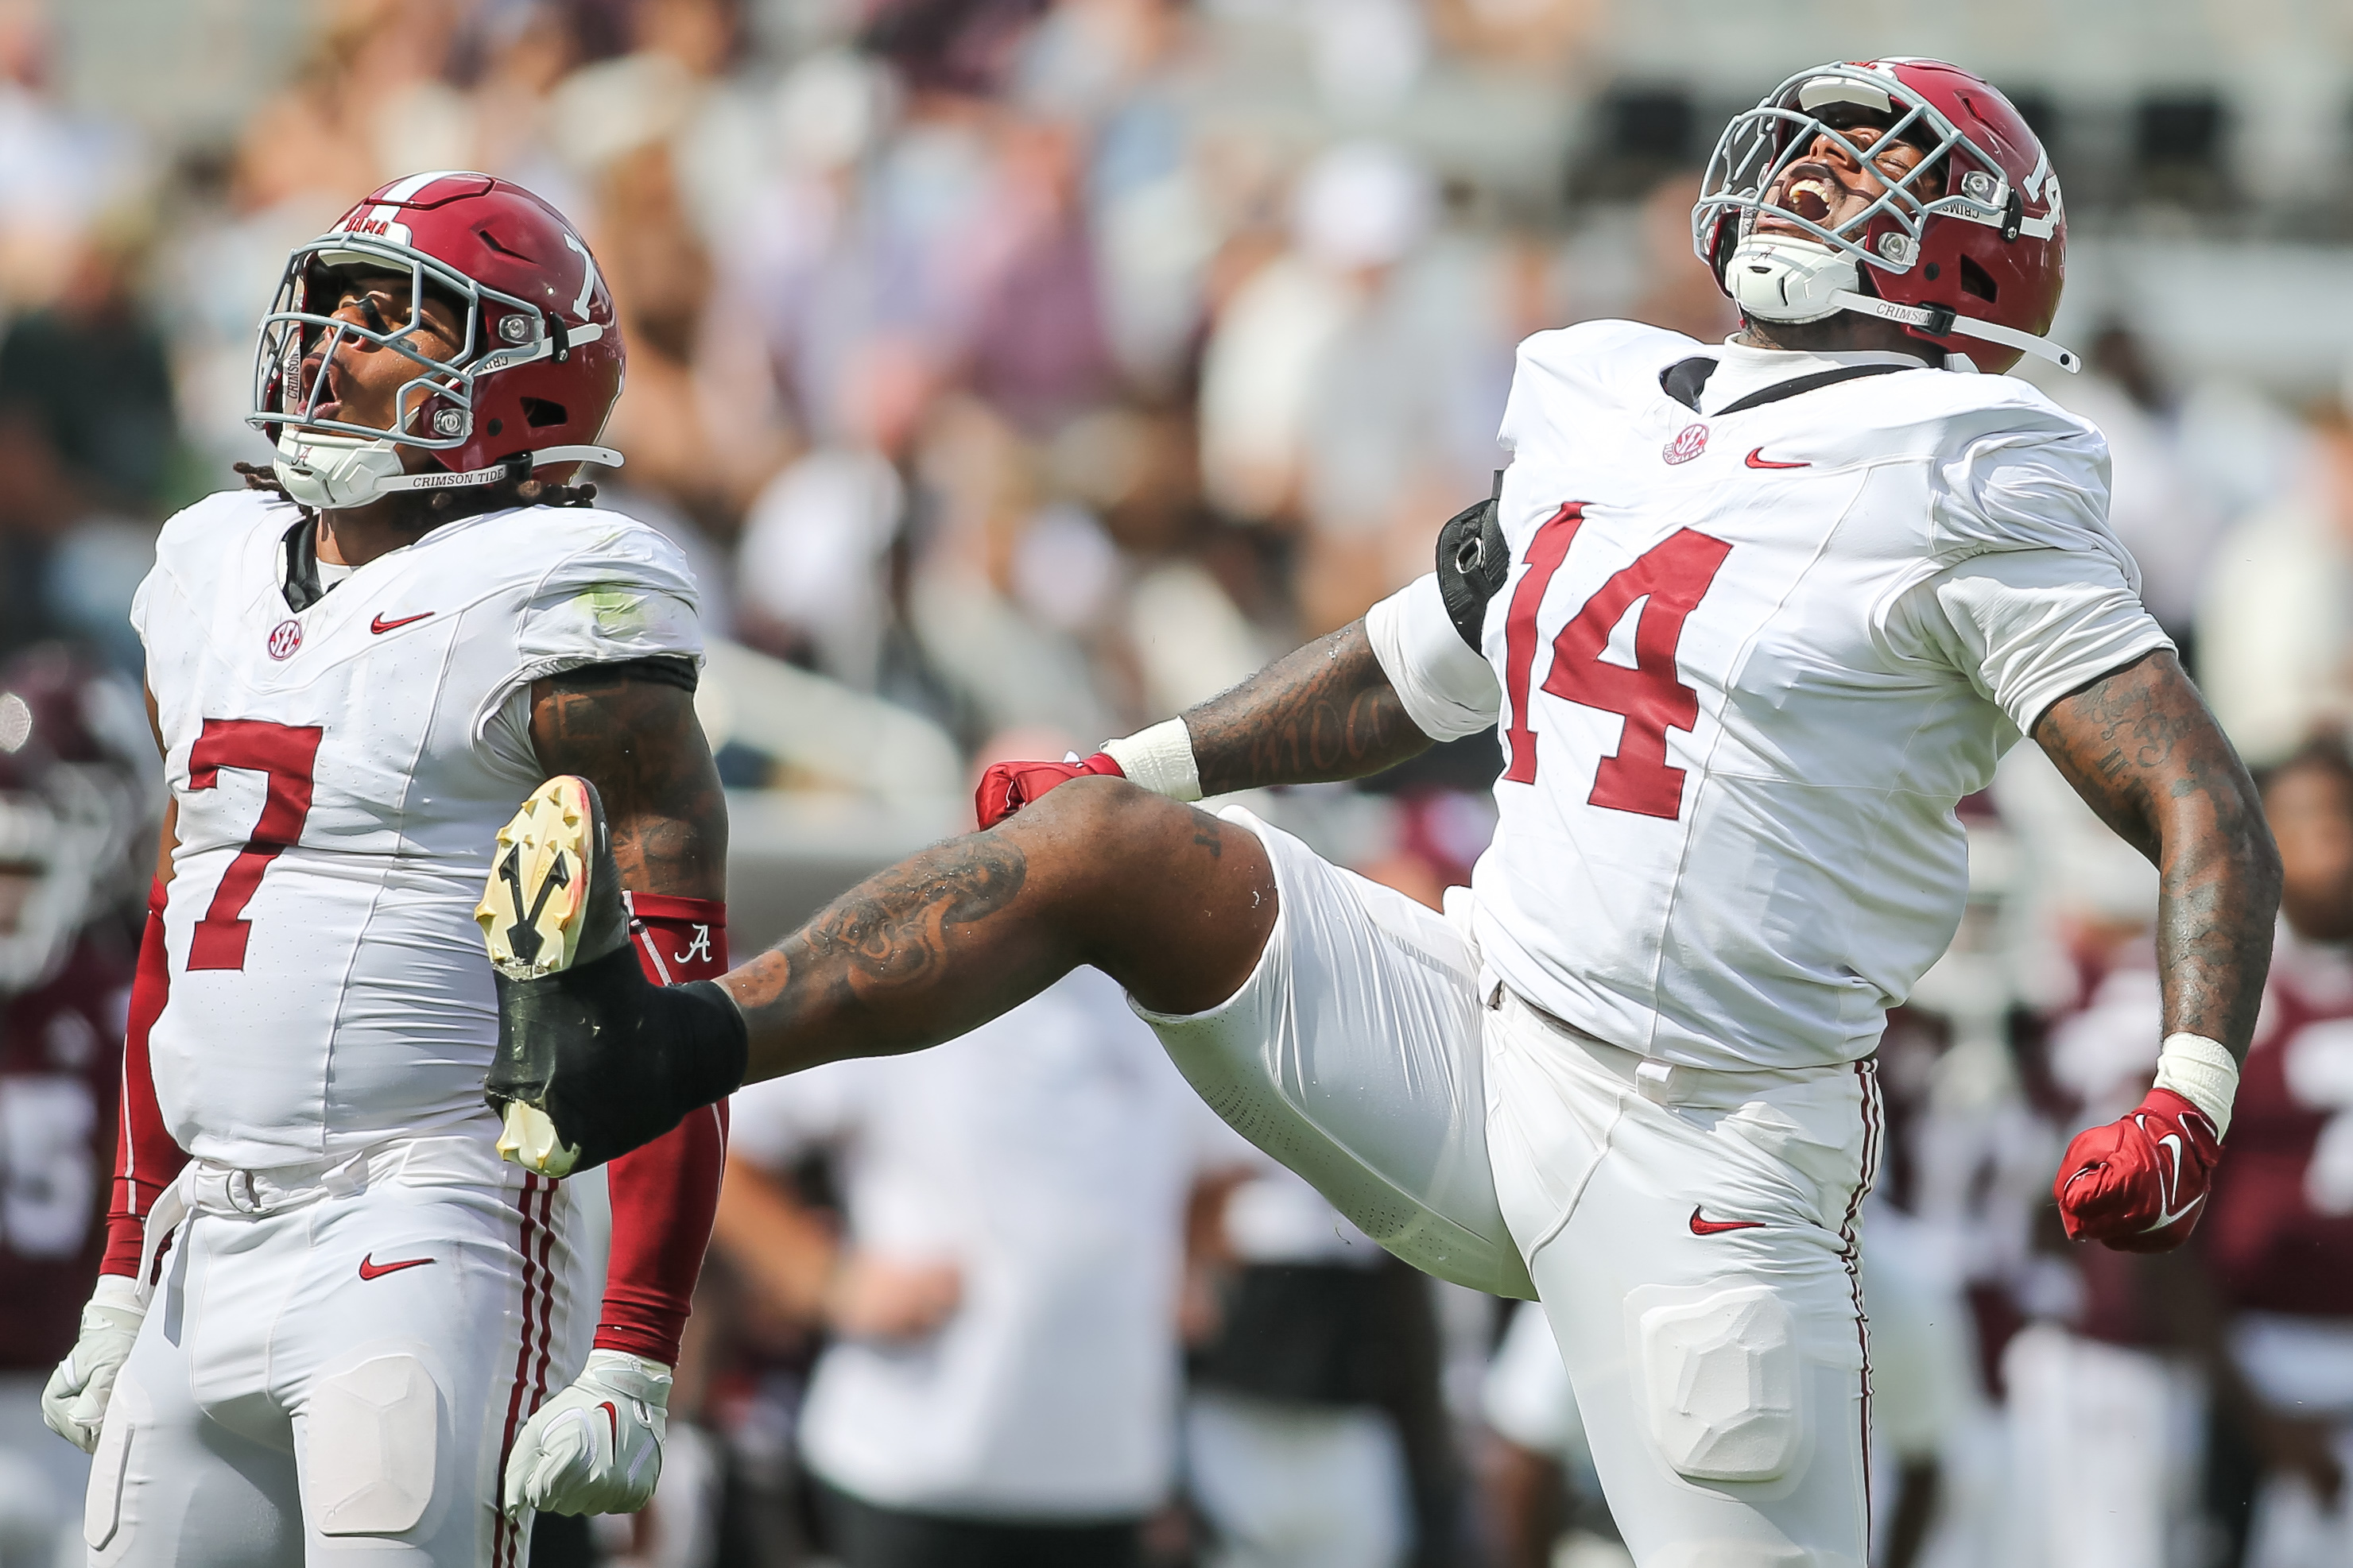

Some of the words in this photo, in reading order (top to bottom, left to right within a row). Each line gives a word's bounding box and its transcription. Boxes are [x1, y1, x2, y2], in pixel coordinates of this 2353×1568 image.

[1673, 424, 1708, 456] SEC
[413, 473, 474, 488] CRIMSON
[478, 467, 505, 482] TIDE
[269, 621, 301, 659] SEC
[1502, 501, 1734, 821] 14
[186, 718, 324, 972] 7
[673, 923, 712, 964] A
